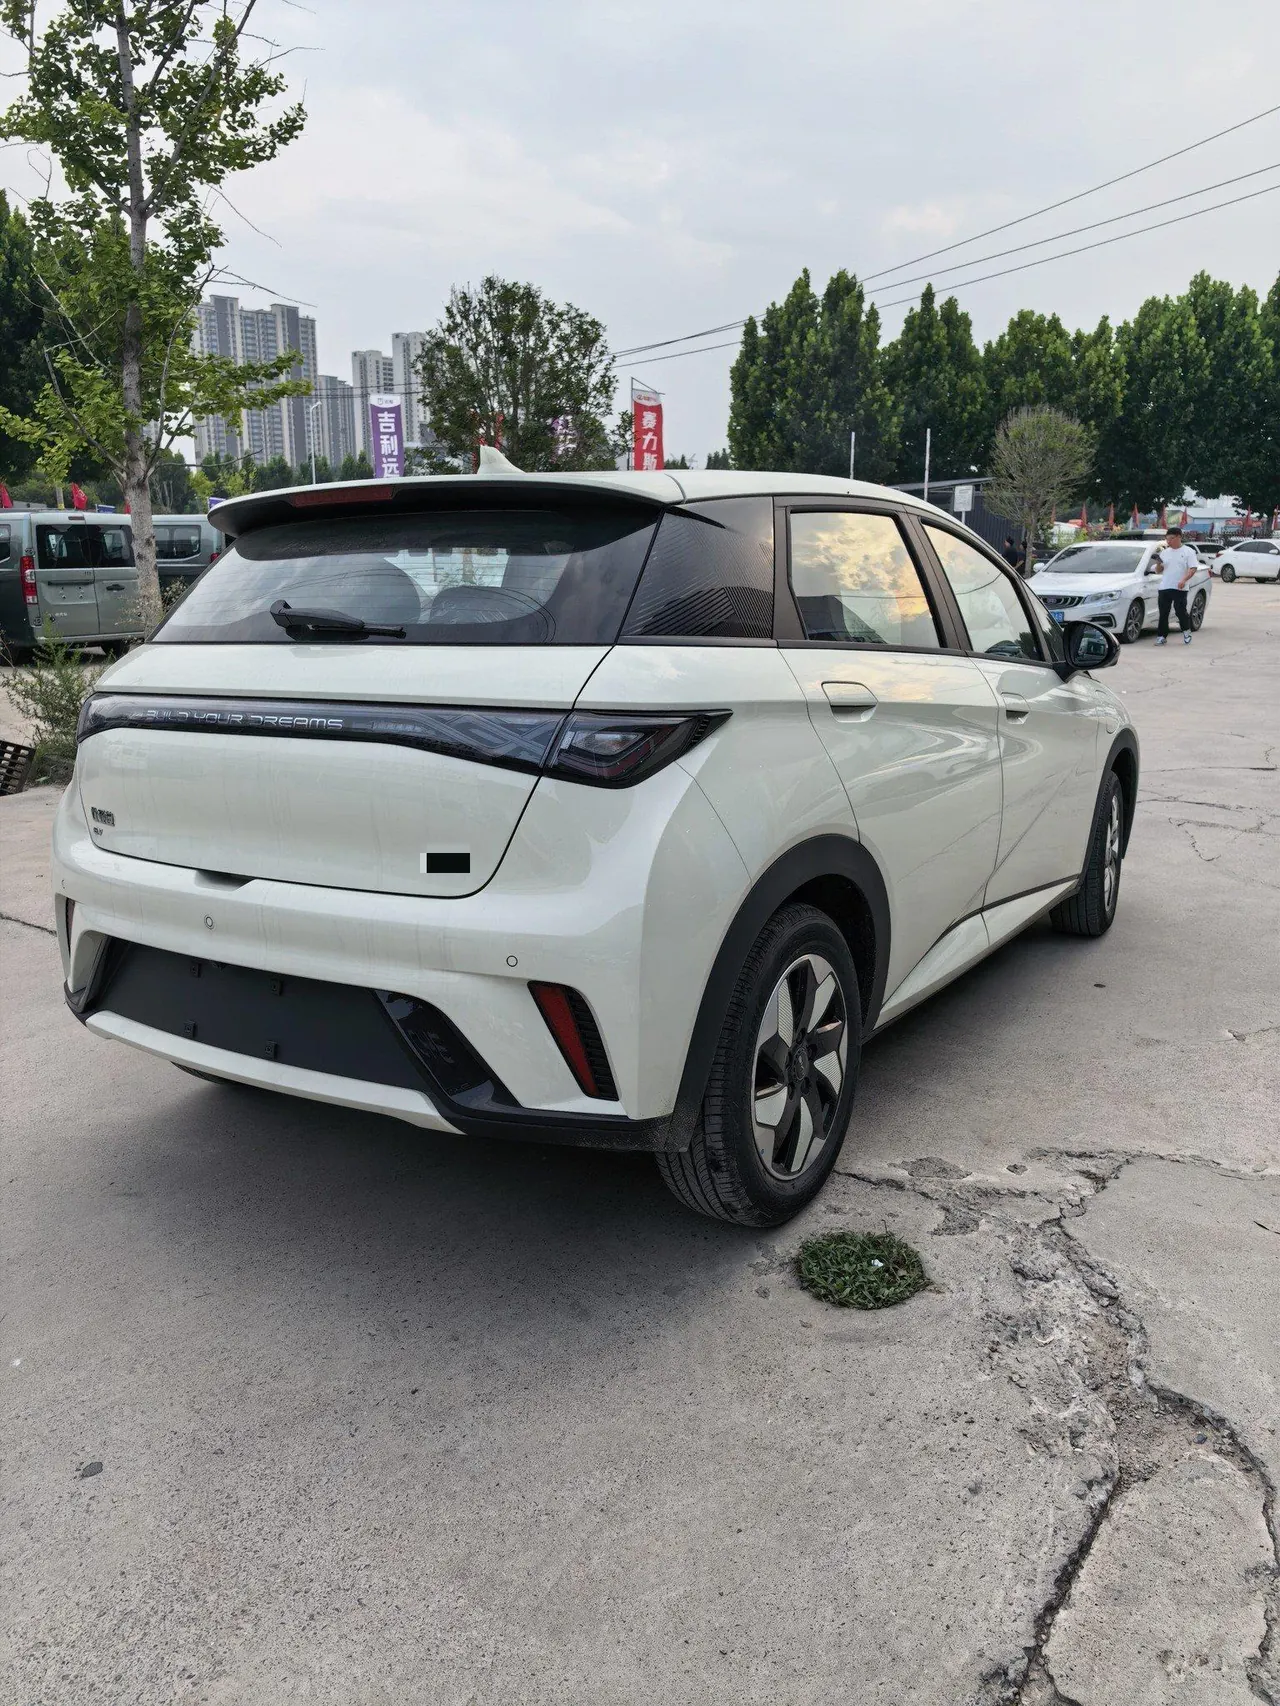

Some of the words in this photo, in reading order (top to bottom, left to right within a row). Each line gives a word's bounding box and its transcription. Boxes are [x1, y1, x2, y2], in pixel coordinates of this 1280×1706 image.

[377, 411, 400, 478] 吉利远
[147, 710, 189, 722] BUILD
[194, 713, 244, 725] YOUR
[250, 715, 343, 730] DREAMS
